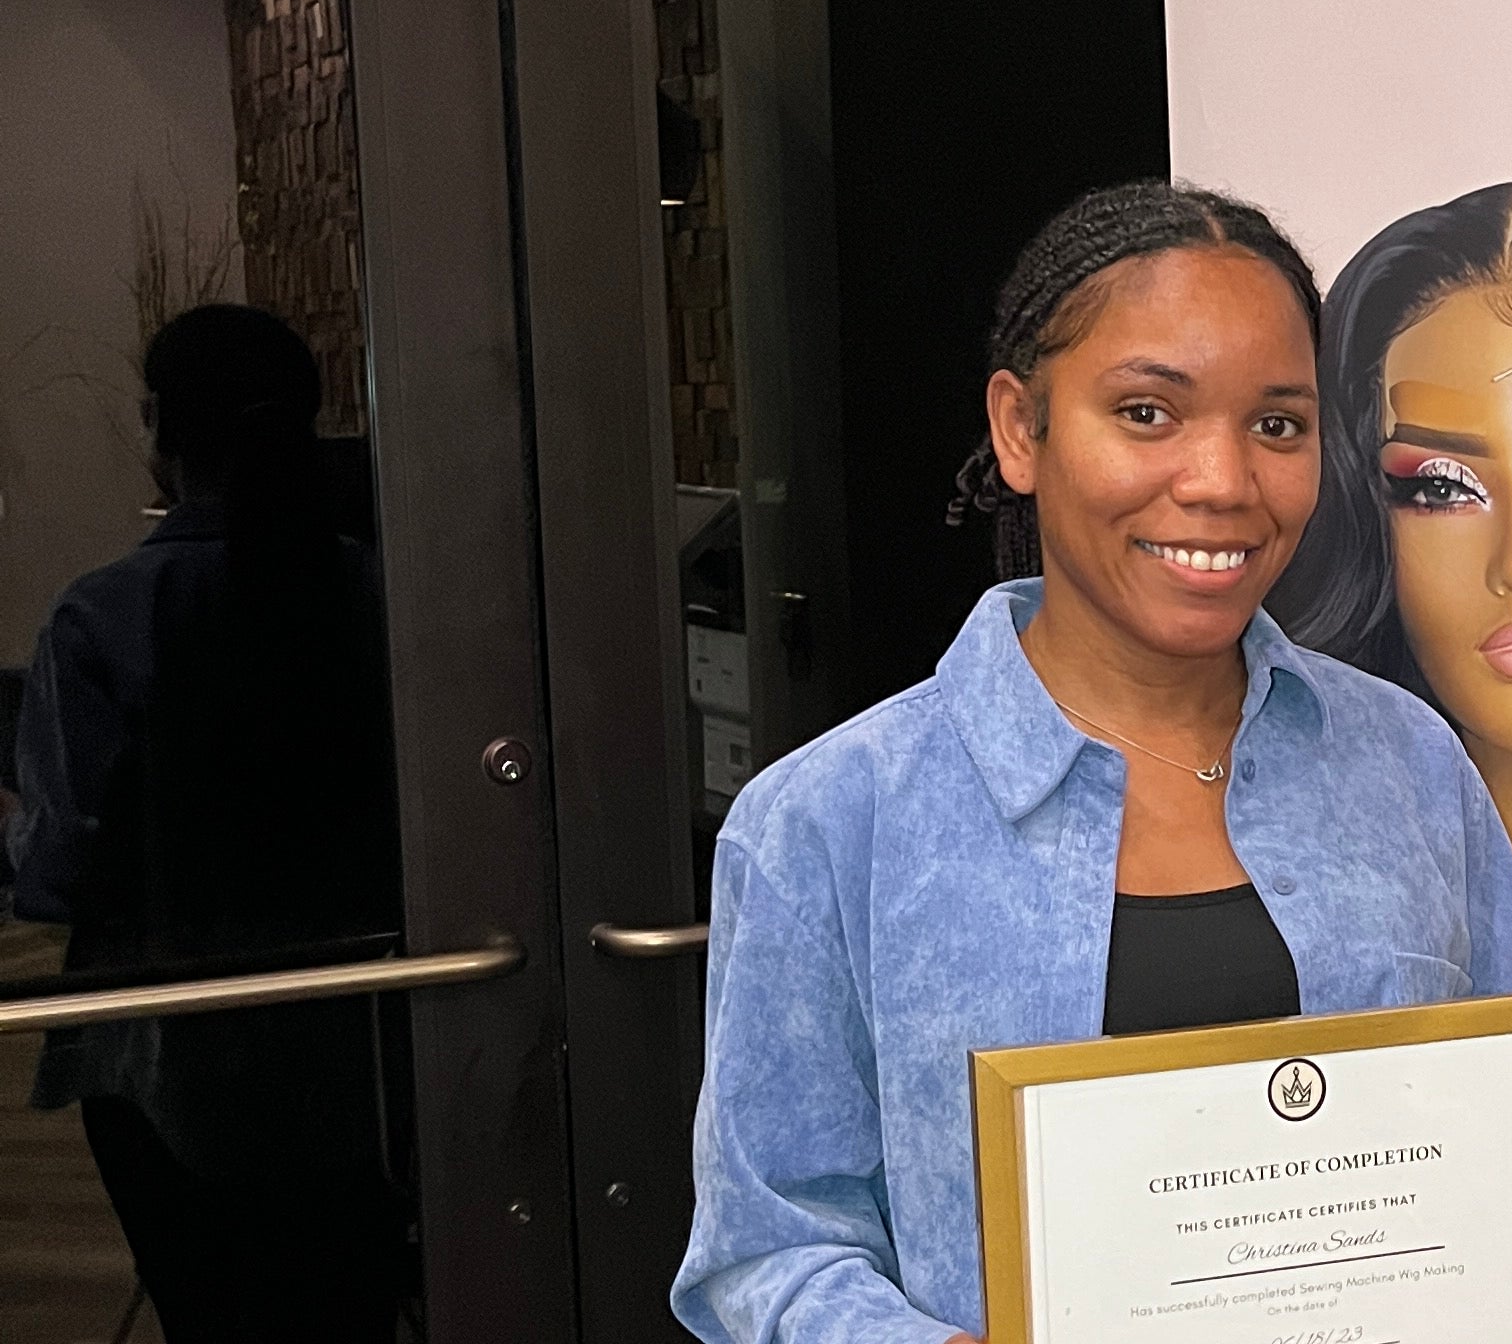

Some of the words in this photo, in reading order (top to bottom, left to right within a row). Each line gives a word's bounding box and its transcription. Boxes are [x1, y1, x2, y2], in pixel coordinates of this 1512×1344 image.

[1149, 1163, 1281, 1194] CERTIFICATE
[1285, 1159, 1311, 1178] OF
[1315, 1143, 1443, 1174] COMPLETION
[1176, 1220, 1208, 1235] THIS
[1214, 1207, 1303, 1231] CERTIFICATE
[1308, 1198, 1377, 1218] CERTIFIES
[1382, 1193, 1417, 1209] THAT
[1227, 1239, 1320, 1265] Christina
[1323, 1228, 1388, 1253] Sands
[1130, 1305, 1153, 1318] Has
[1157, 1294, 1229, 1314] successfully
[1232, 1285, 1296, 1305] completed
[1299, 1278, 1343, 1294] Sewing
[1346, 1272, 1395, 1288] Machine
[1398, 1268, 1421, 1281] Wig
[1424, 1263, 1465, 1277] Making
[1267, 1305, 1282, 1316] On
[1284, 1303, 1299, 1314] the
[1302, 1300, 1325, 1312] date
[1328, 1298, 1338, 1309] of
